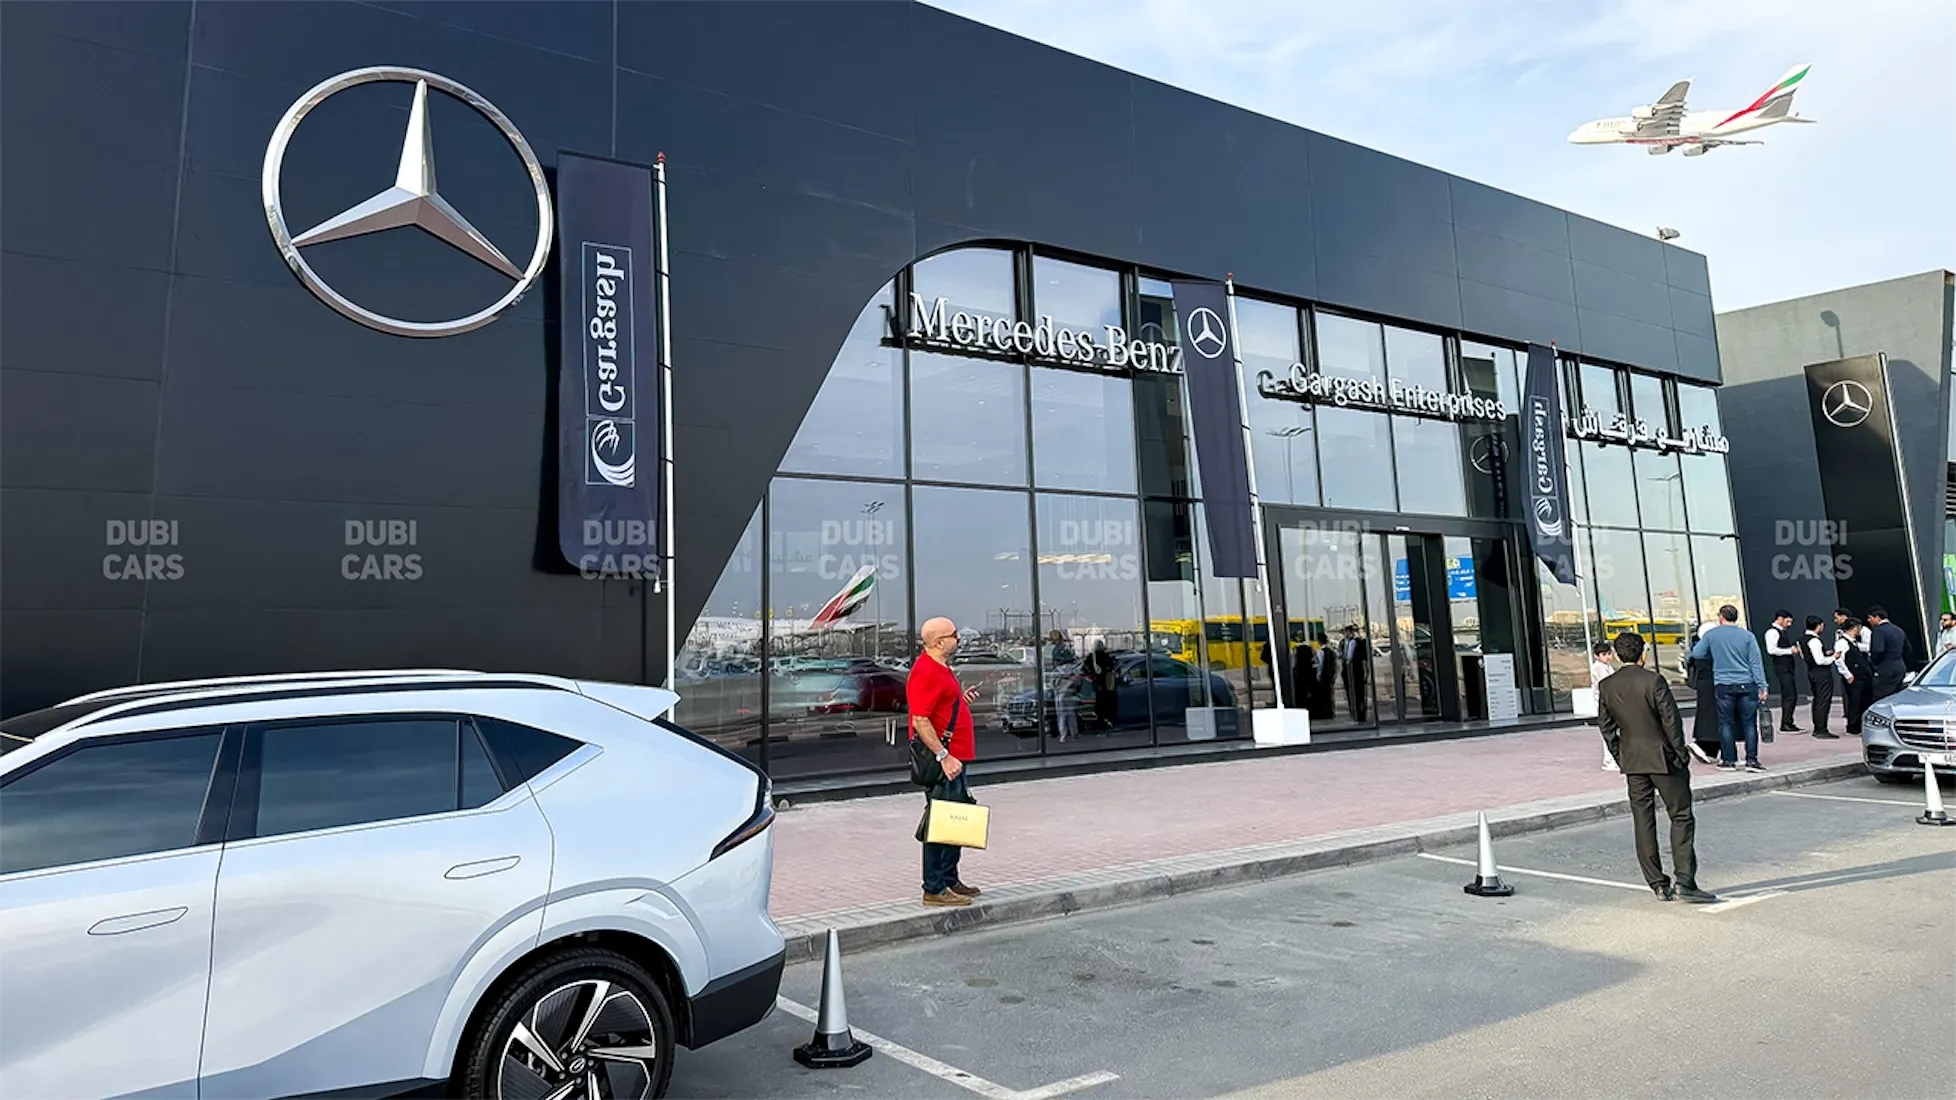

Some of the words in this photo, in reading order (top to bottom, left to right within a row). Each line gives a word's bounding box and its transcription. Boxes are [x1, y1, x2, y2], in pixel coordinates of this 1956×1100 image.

[909, 293, 1185, 374] Mercedes-Benz
[1289, 363, 1385, 406] Gargash
[1390, 378, 1507, 421] Enterprises
